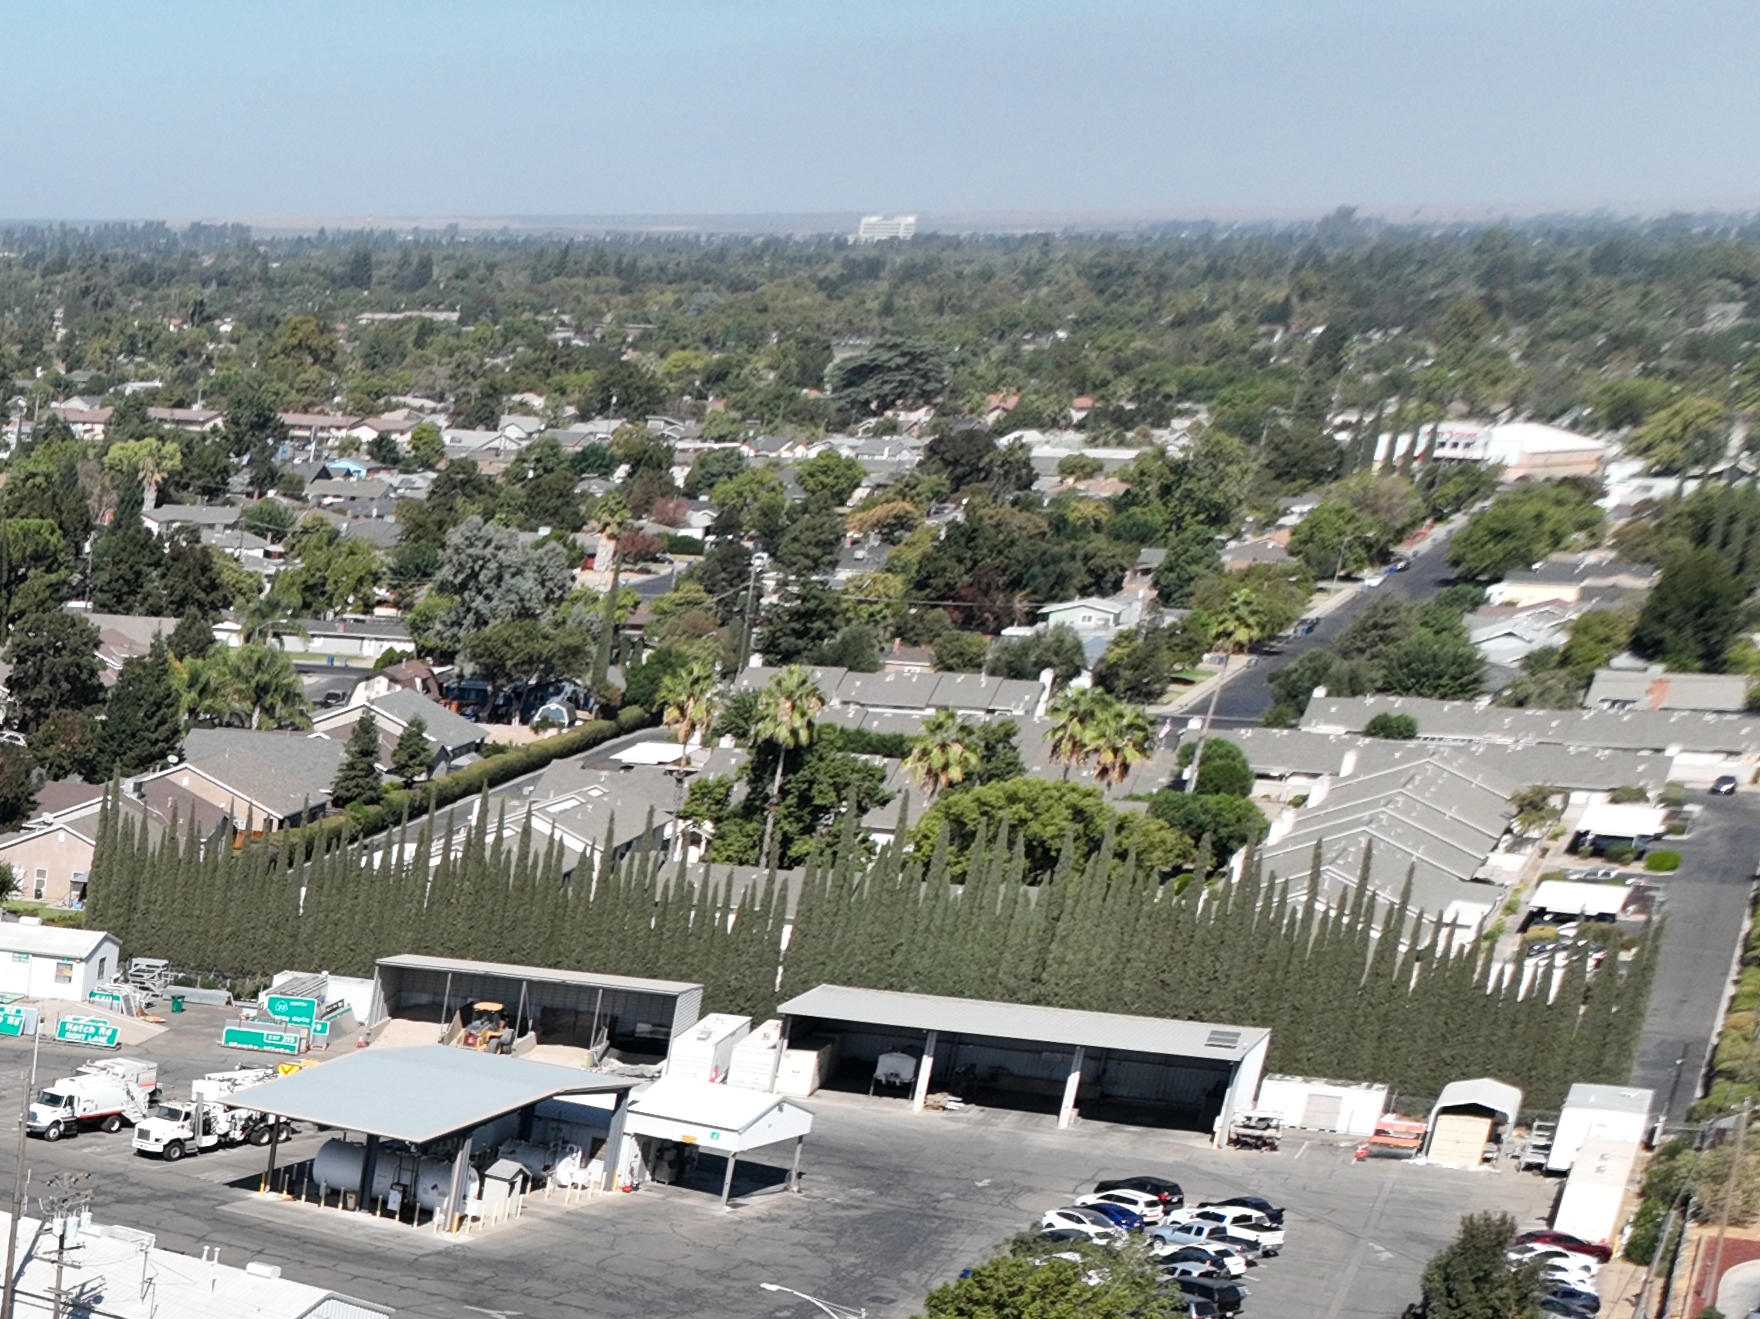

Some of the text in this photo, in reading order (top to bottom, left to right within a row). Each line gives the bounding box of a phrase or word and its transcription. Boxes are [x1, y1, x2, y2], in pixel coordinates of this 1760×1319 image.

[7, 1016, 21, 1027] Rd
[65, 1022, 112, 1036] Hatch Rd
